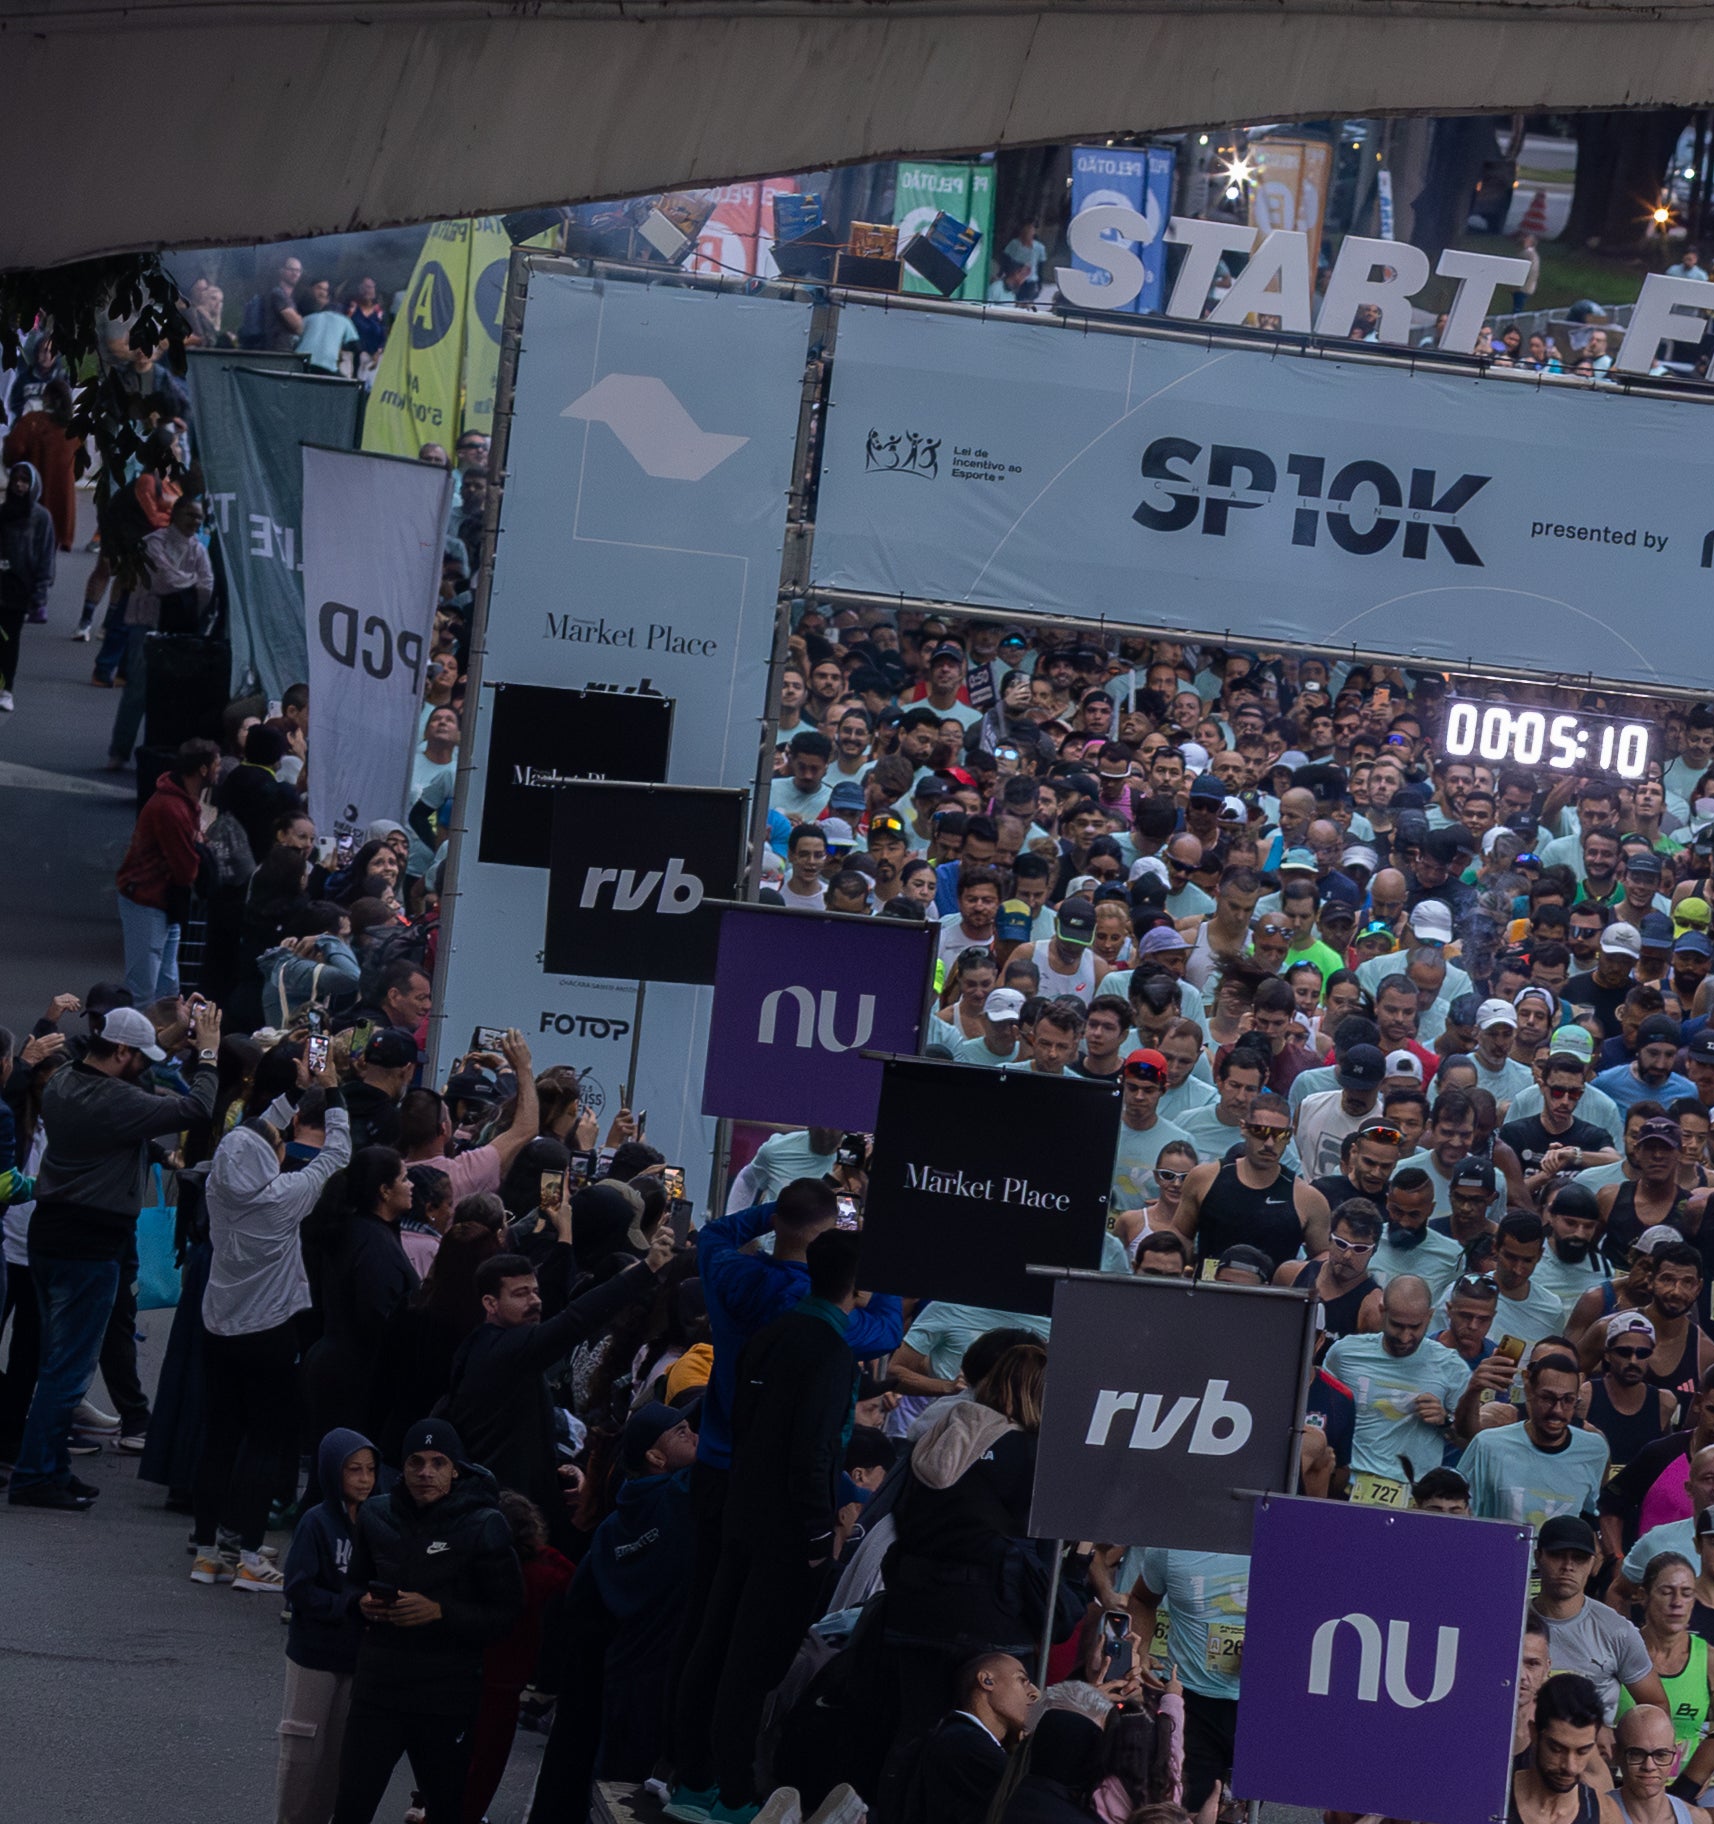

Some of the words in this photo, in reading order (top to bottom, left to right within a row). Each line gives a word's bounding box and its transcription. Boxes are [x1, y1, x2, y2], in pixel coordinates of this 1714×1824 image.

[1055, 205, 1530, 355] START
[952, 468, 995, 482] Esporte
[954, 446, 971, 456] Lei
[974, 448, 988, 458] de
[1008, 464, 1022, 473] ao
[1131, 436, 1492, 567] SP10K
[1531, 519, 1637, 548] presented
[1643, 533, 1670, 553] by
[543, 611, 637, 649] Market
[646, 621, 718, 658] Place
[580, 858, 706, 916] rvb
[540, 1011, 630, 1042] FOTOP
[757, 985, 876, 1053] nu
[903, 1161, 994, 1201] Market
[1000, 1175, 1073, 1213] Place
[1084, 1379, 1253, 1456] rvb
[1371, 1483, 1399, 1502] 727
[1306, 1612, 1459, 1709] nu
